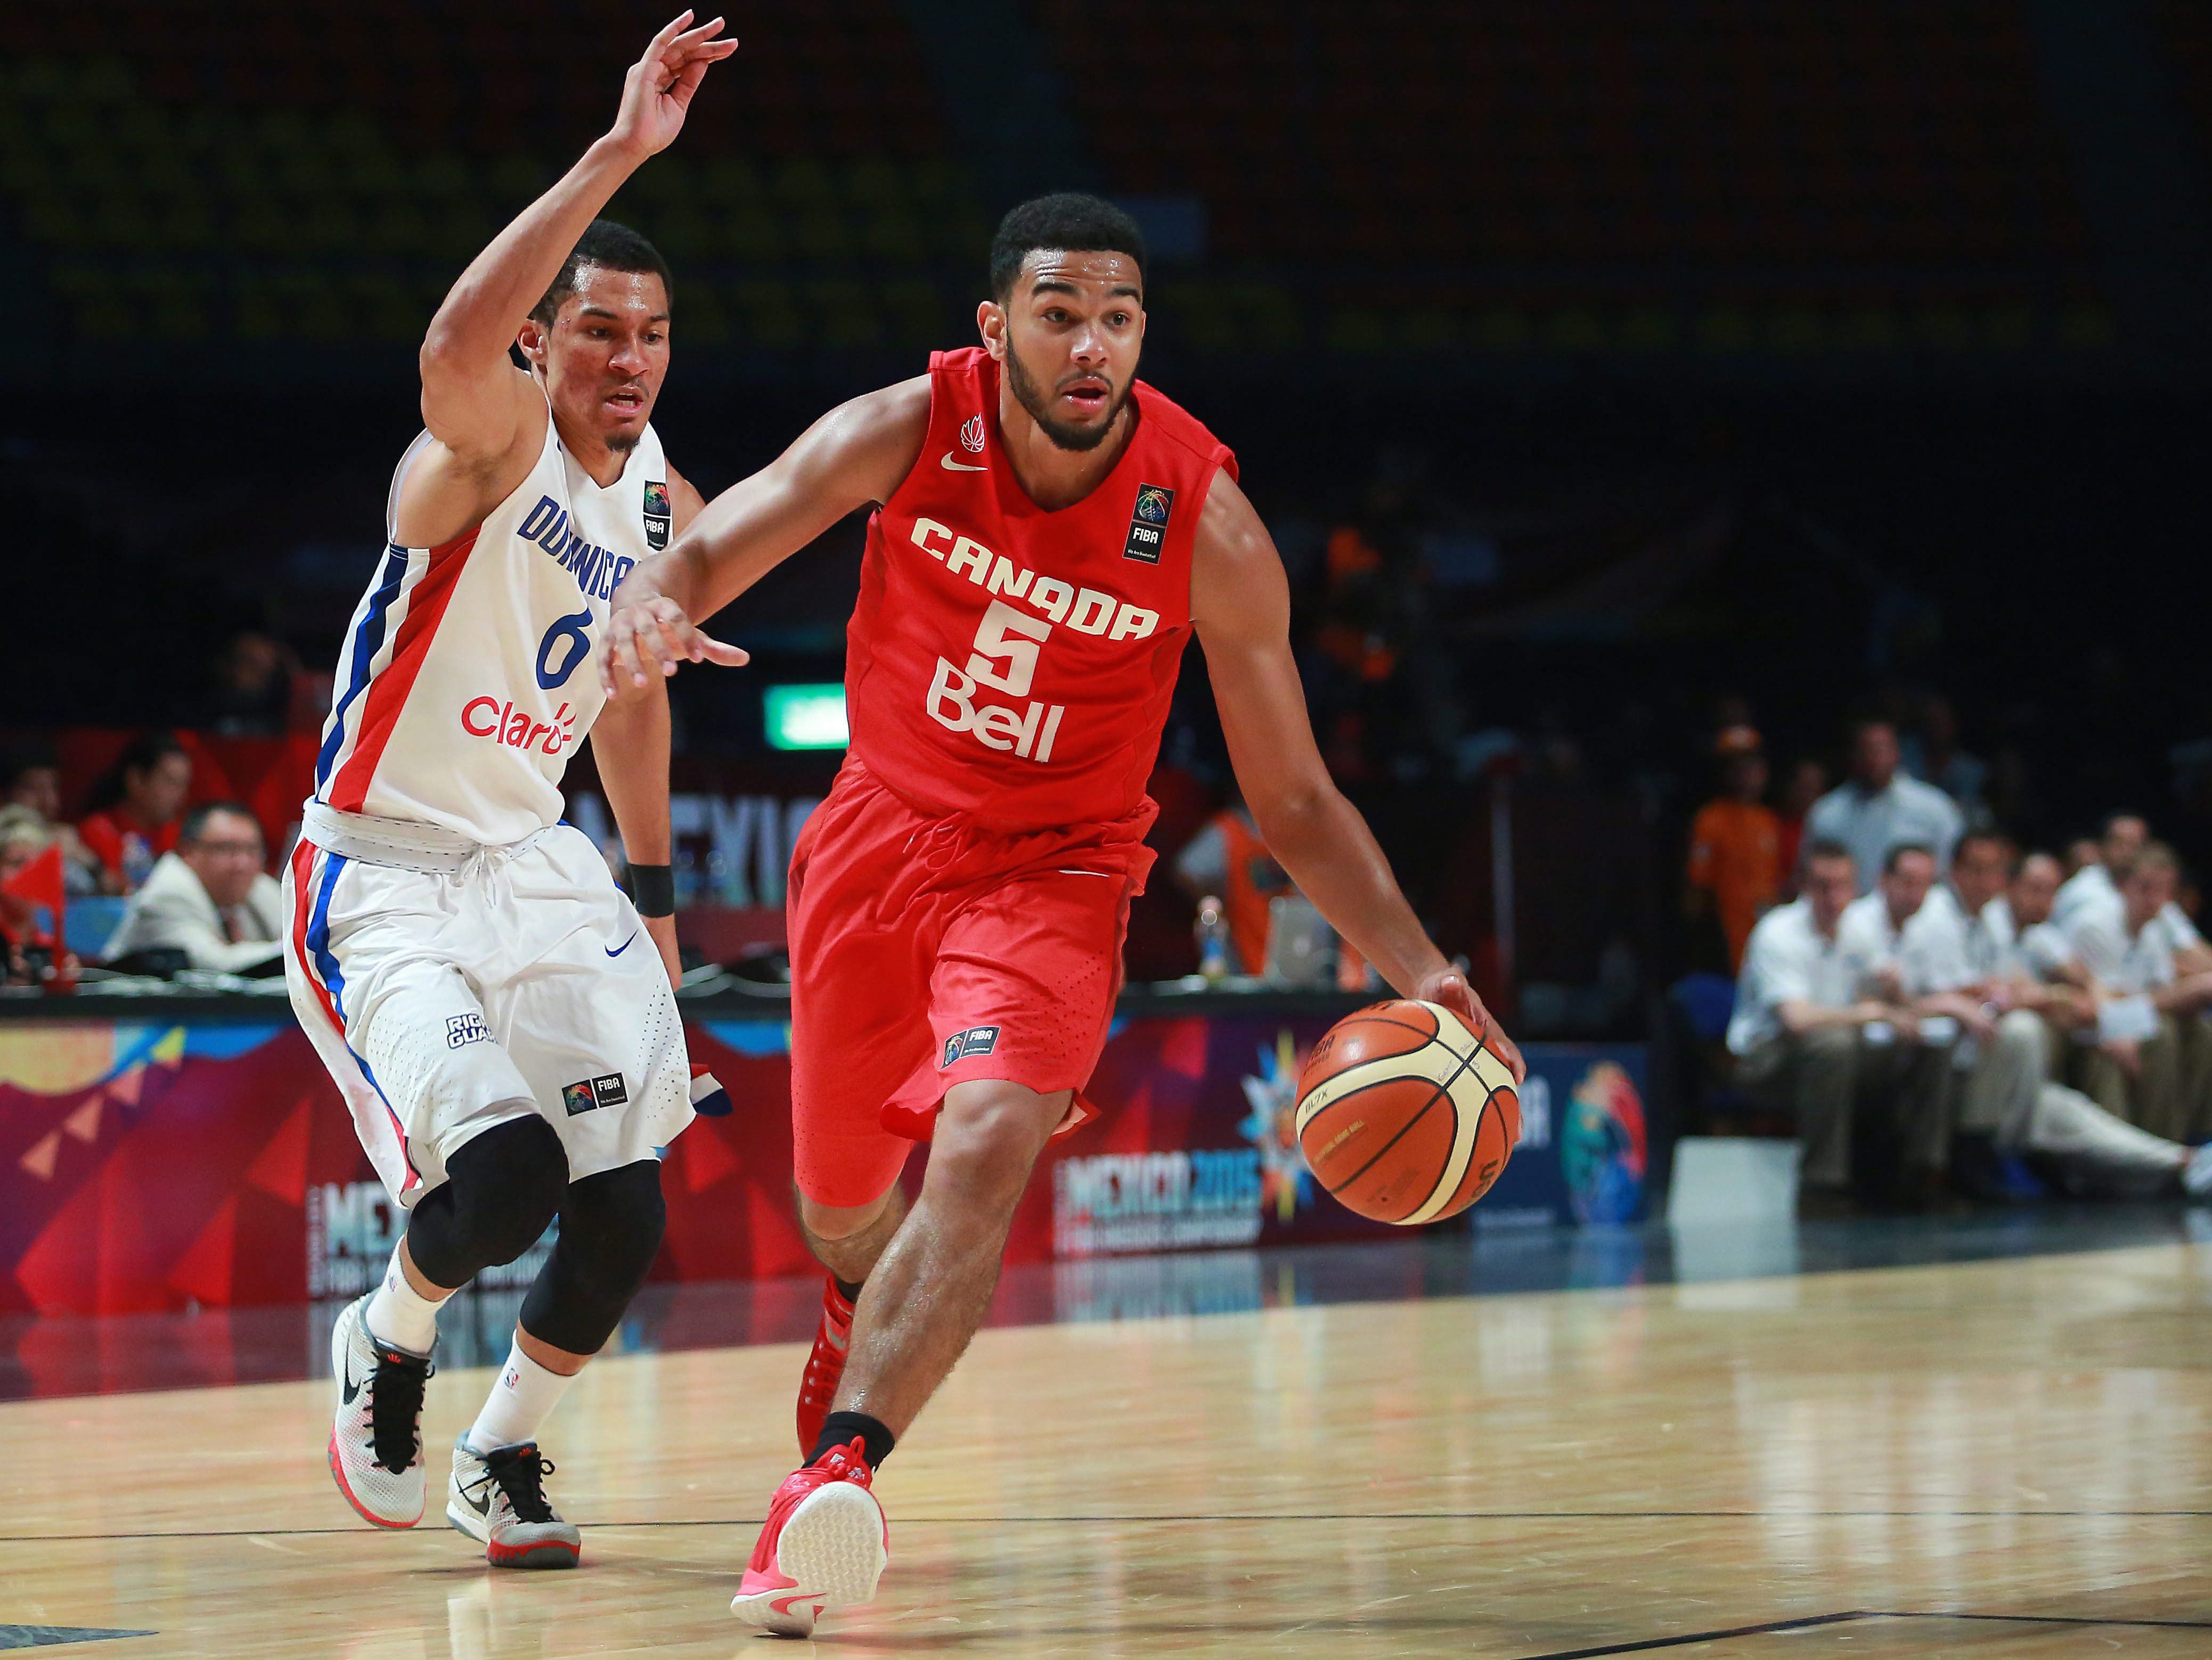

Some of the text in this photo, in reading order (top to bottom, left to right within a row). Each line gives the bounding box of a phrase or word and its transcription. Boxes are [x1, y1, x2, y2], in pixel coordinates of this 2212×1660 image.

[646, 519, 665, 534] FIBA
[1132, 527, 1158, 544] FIBA
[910, 518, 1160, 641] CANADA
[536, 607, 593, 690] 6
[965, 598, 1053, 697] 5
[461, 696, 565, 754] Claro
[927, 656, 1065, 763] Bell
[969, 1030, 993, 1042] FIBA
[597, 1077, 621, 1092] FIBA
